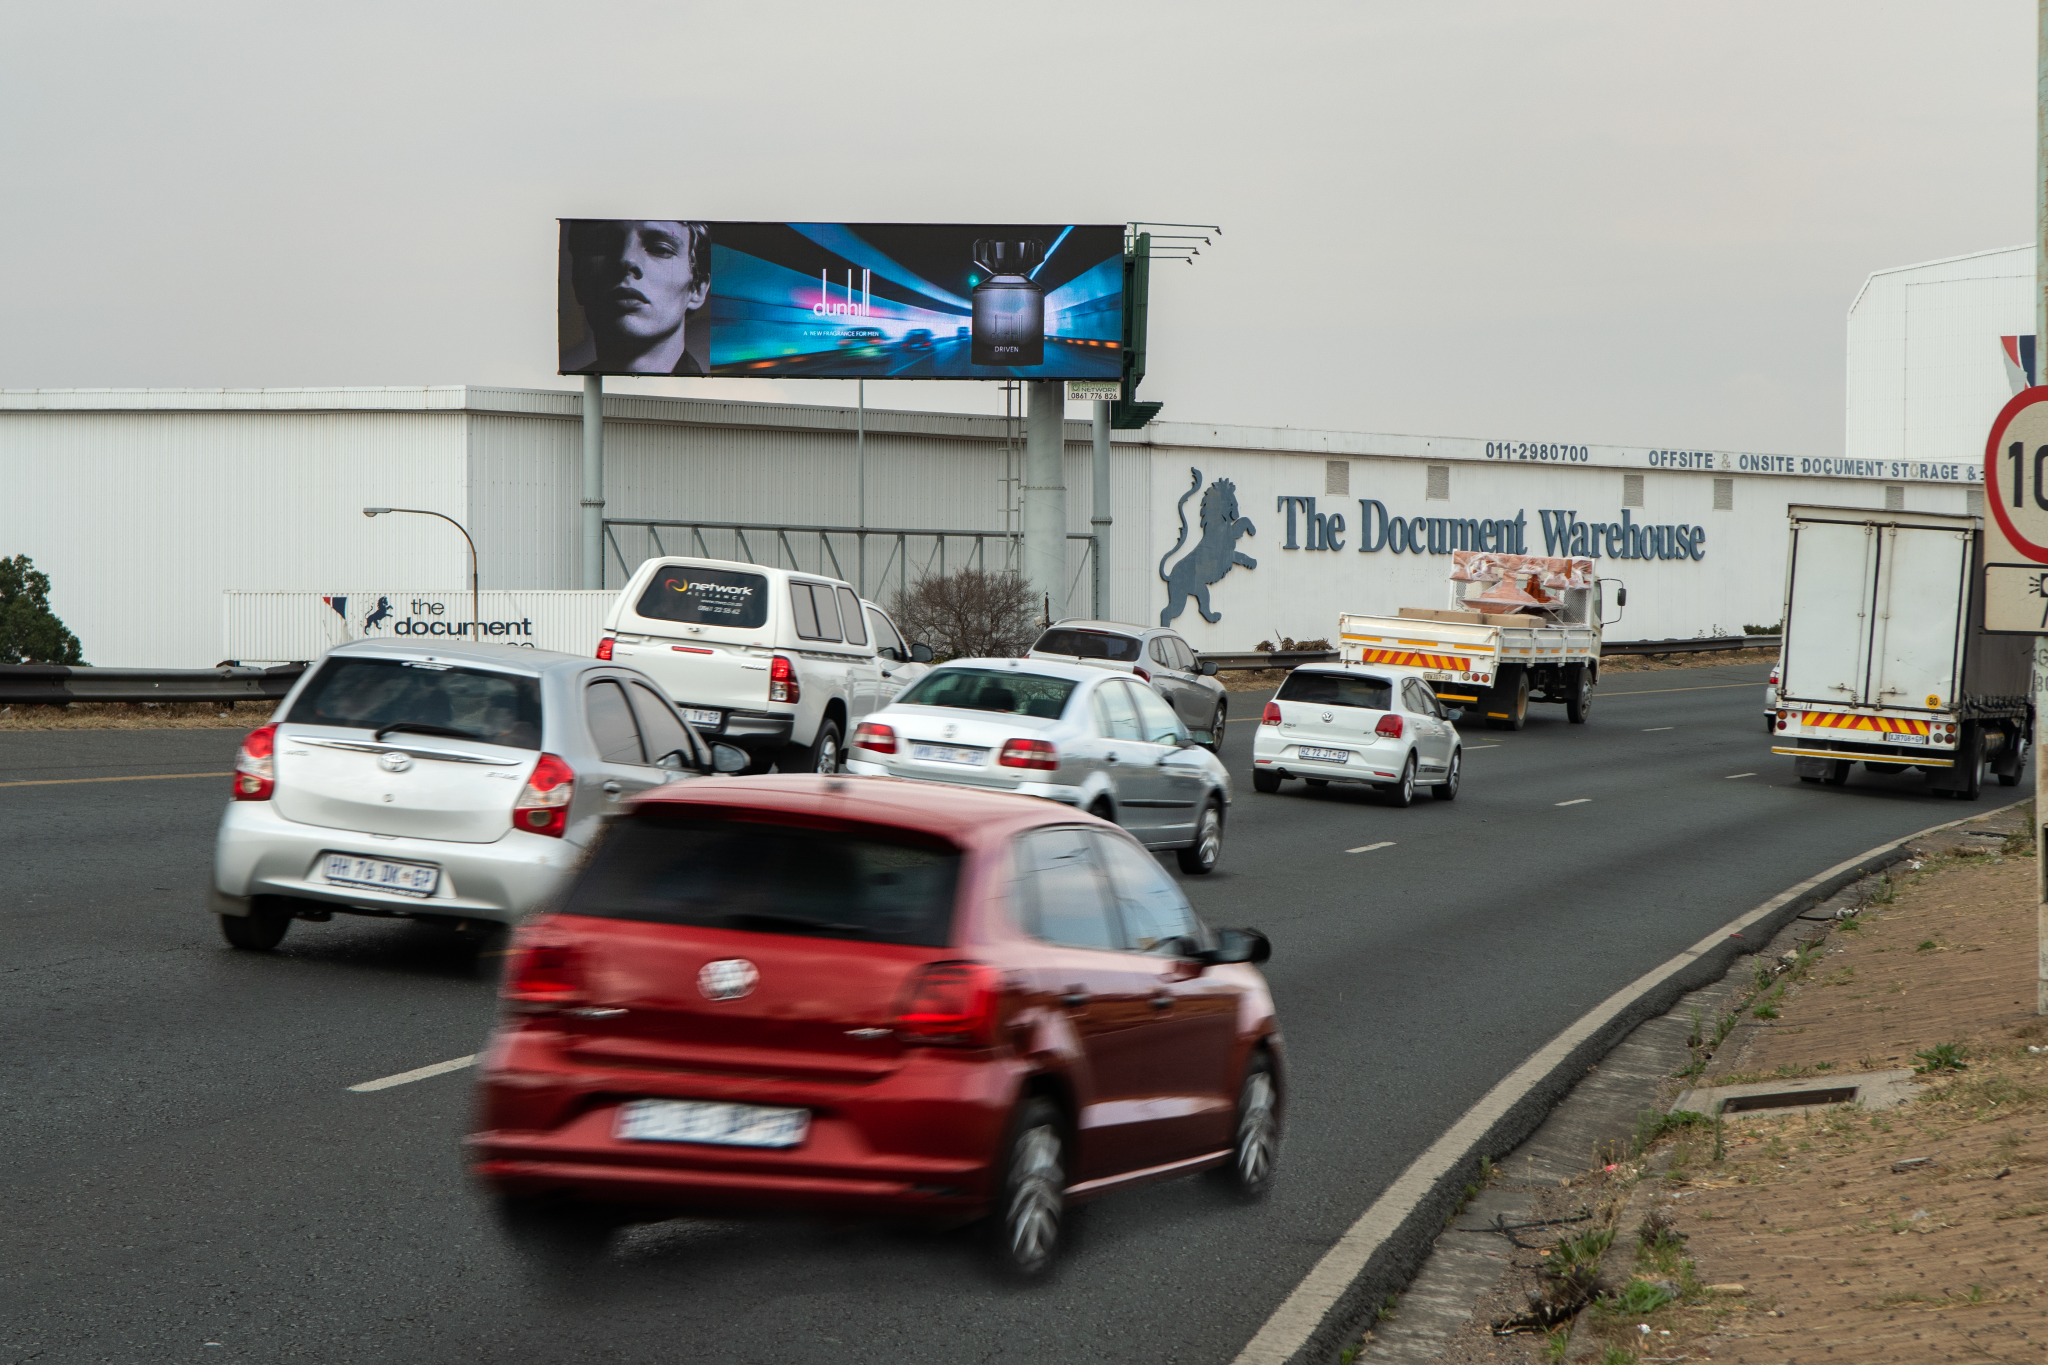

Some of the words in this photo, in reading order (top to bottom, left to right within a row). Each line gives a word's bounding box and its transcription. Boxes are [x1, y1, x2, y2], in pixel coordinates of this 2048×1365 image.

[813, 268, 870, 316] dunhill
[1104, 392, 1118, 400] 826
[1485, 442, 1588, 462] 011-2980700
[1648, 450, 1713, 469] OFFSITE
[1739, 454, 1795, 472] ONSITE
[1802, 458, 1884, 477] DOCUMENT
[1891, 462, 1958, 480] STORAGE
[1277, 495, 1346, 551] The
[1358, 498, 1527, 555] Document
[1538, 508, 1706, 561] Warehouse
[688, 582, 753, 596] network
[410, 598, 445, 616] the
[394, 616, 532, 636] document
[1928, 697, 1938, 706] 80
